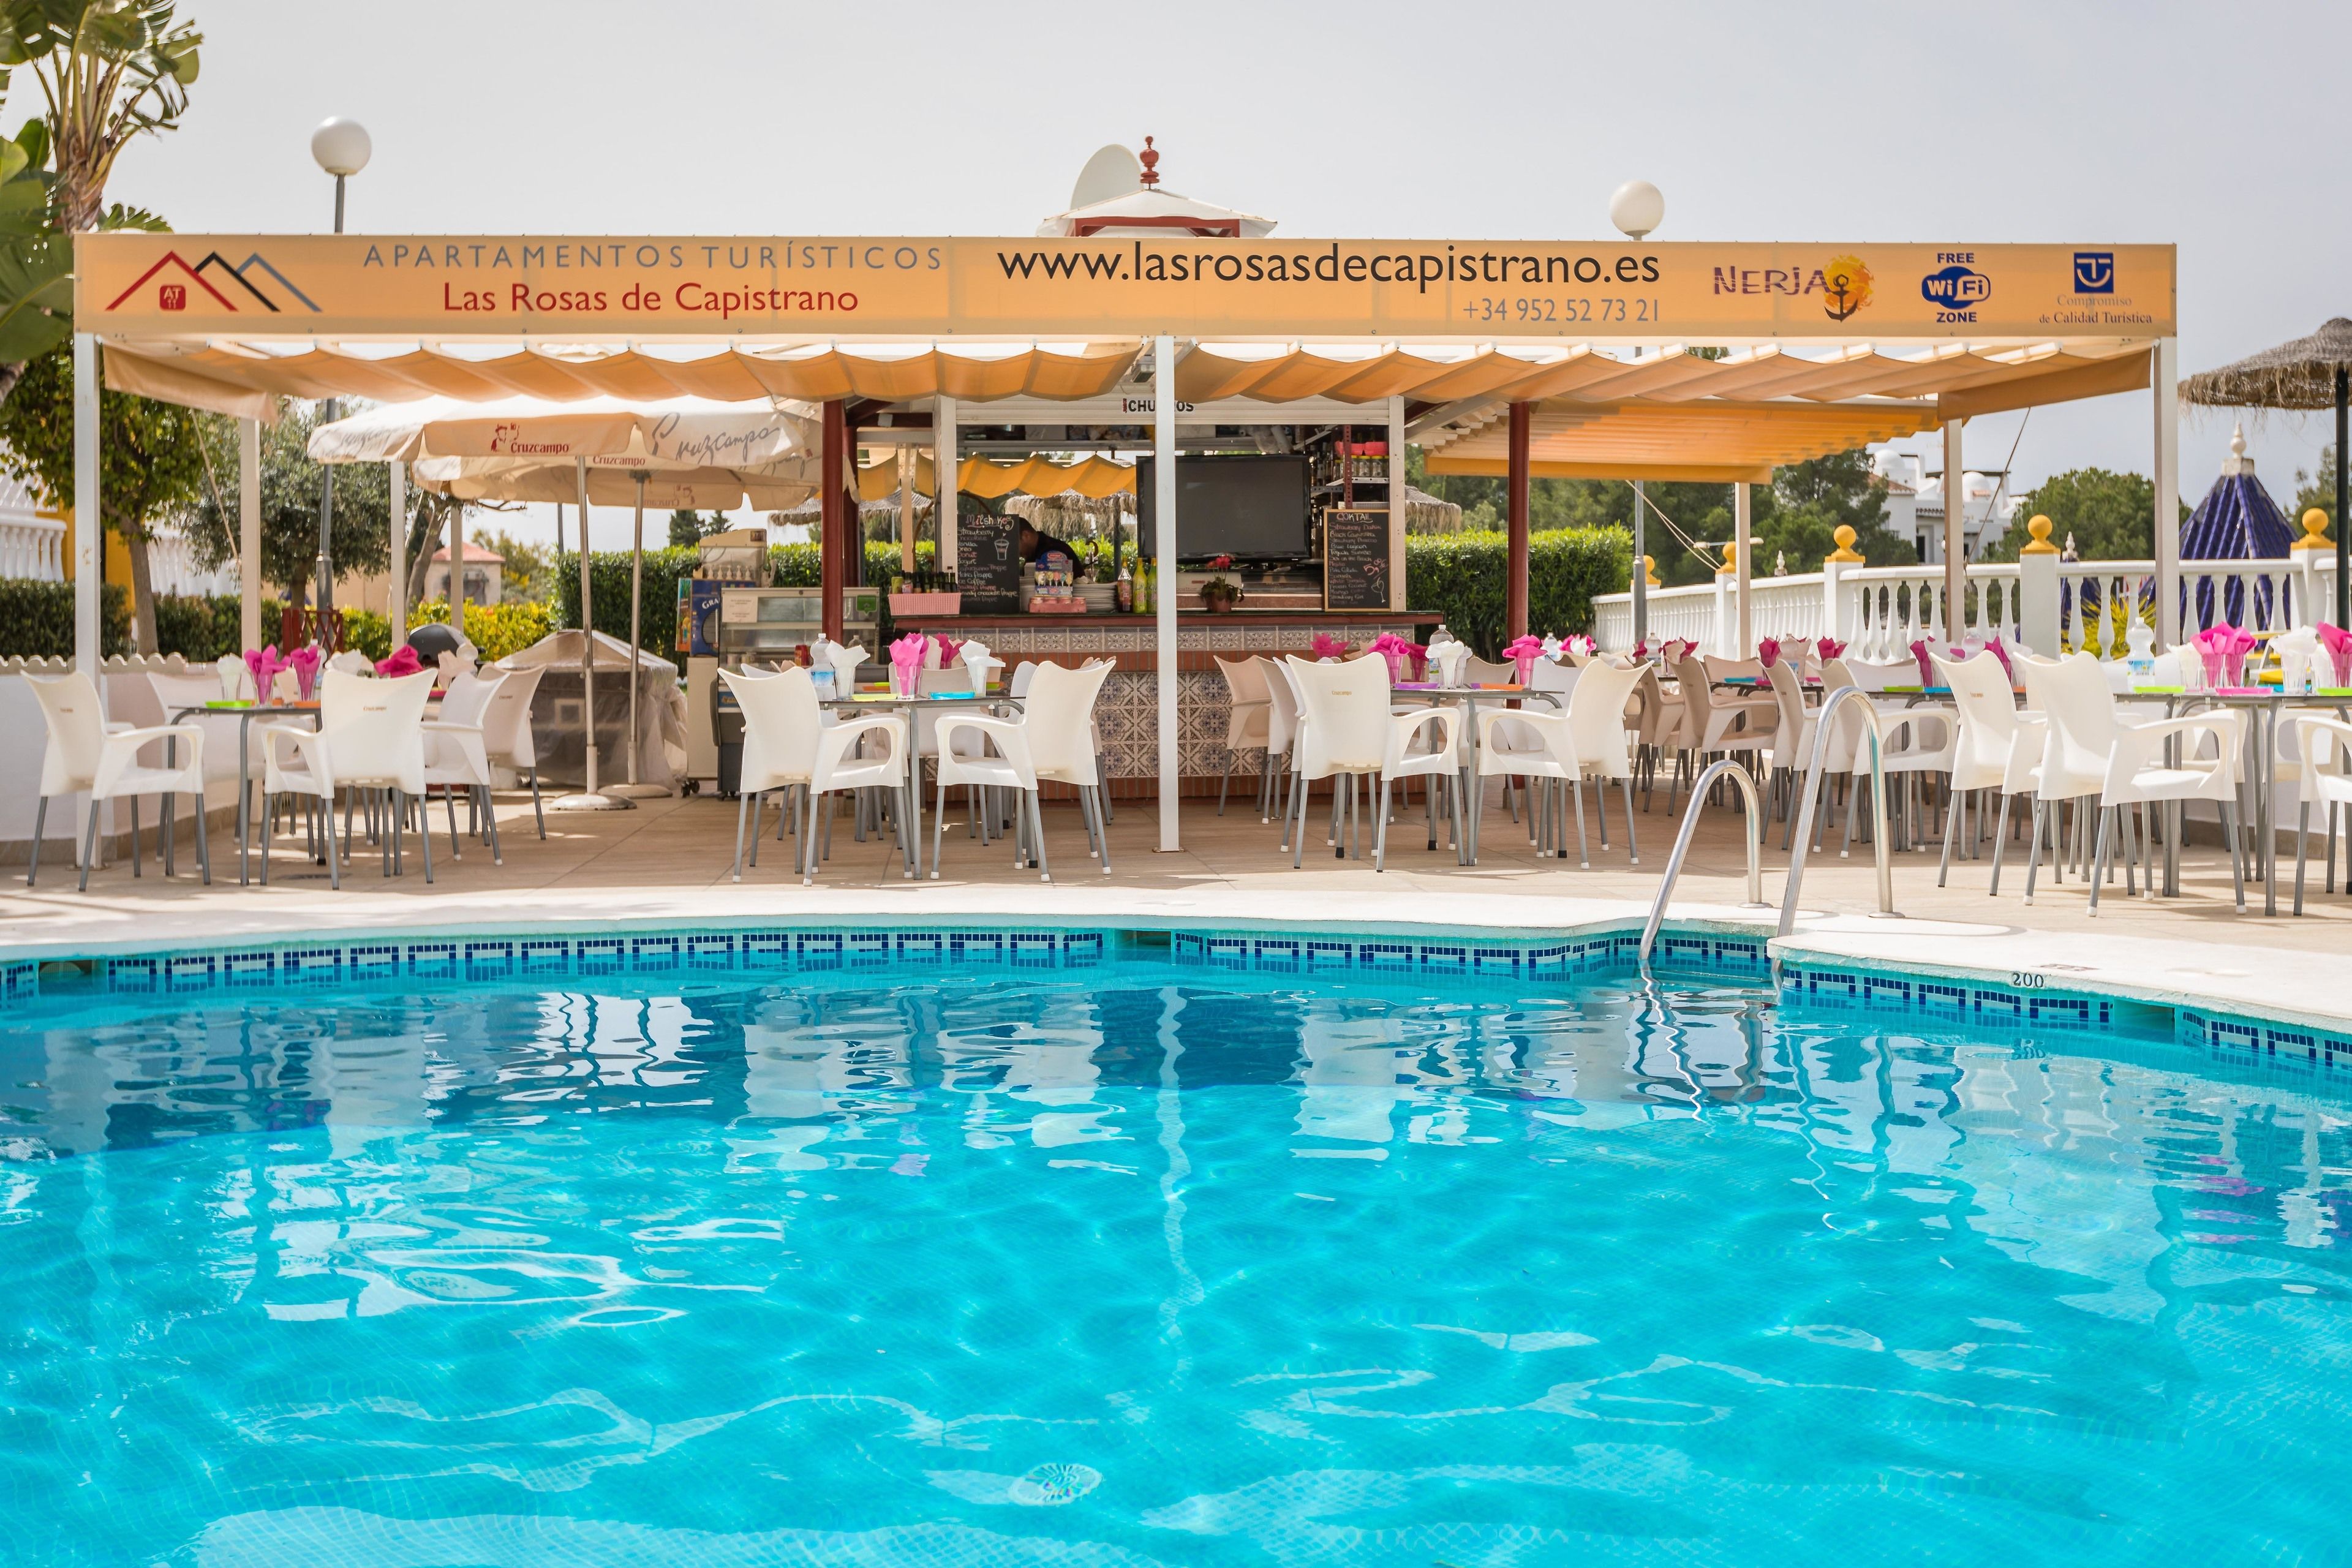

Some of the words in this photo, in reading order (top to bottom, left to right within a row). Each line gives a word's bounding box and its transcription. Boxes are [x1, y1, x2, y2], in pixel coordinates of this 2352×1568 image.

[363, 244, 683, 268] APARTAMENTOS
[701, 241, 941, 270] TURÍSTICOS
[1937, 253, 1975, 263] FREE
[997, 241, 1660, 294] www.lasrosasdecapistrano.es
[164, 287, 182, 300] AT
[444, 282, 496, 312] Las
[511, 282, 608, 312] Rosas
[622, 282, 661, 311] de
[675, 282, 858, 320] Capistrano
[2057, 295, 2132, 307] Compromiso
[1463, 298, 1507, 320] +34
[1517, 298, 1556, 321] 952
[1566, 299, 1592, 322] 52
[1601, 299, 1626, 322] 73
[1636, 299, 1658, 322] 21
[1936, 312, 1977, 323] ZONE
[2039, 315, 2050, 323] de
[2054, 312, 2099, 323] Calidad
[2103, 312, 2152, 324] Turística
[1128, 400, 1194, 412] CHUOS
[510, 442, 570, 454] Cruzcampo
[592, 455, 646, 467] Cruzcampo
[2012, 971, 2045, 988] 200
